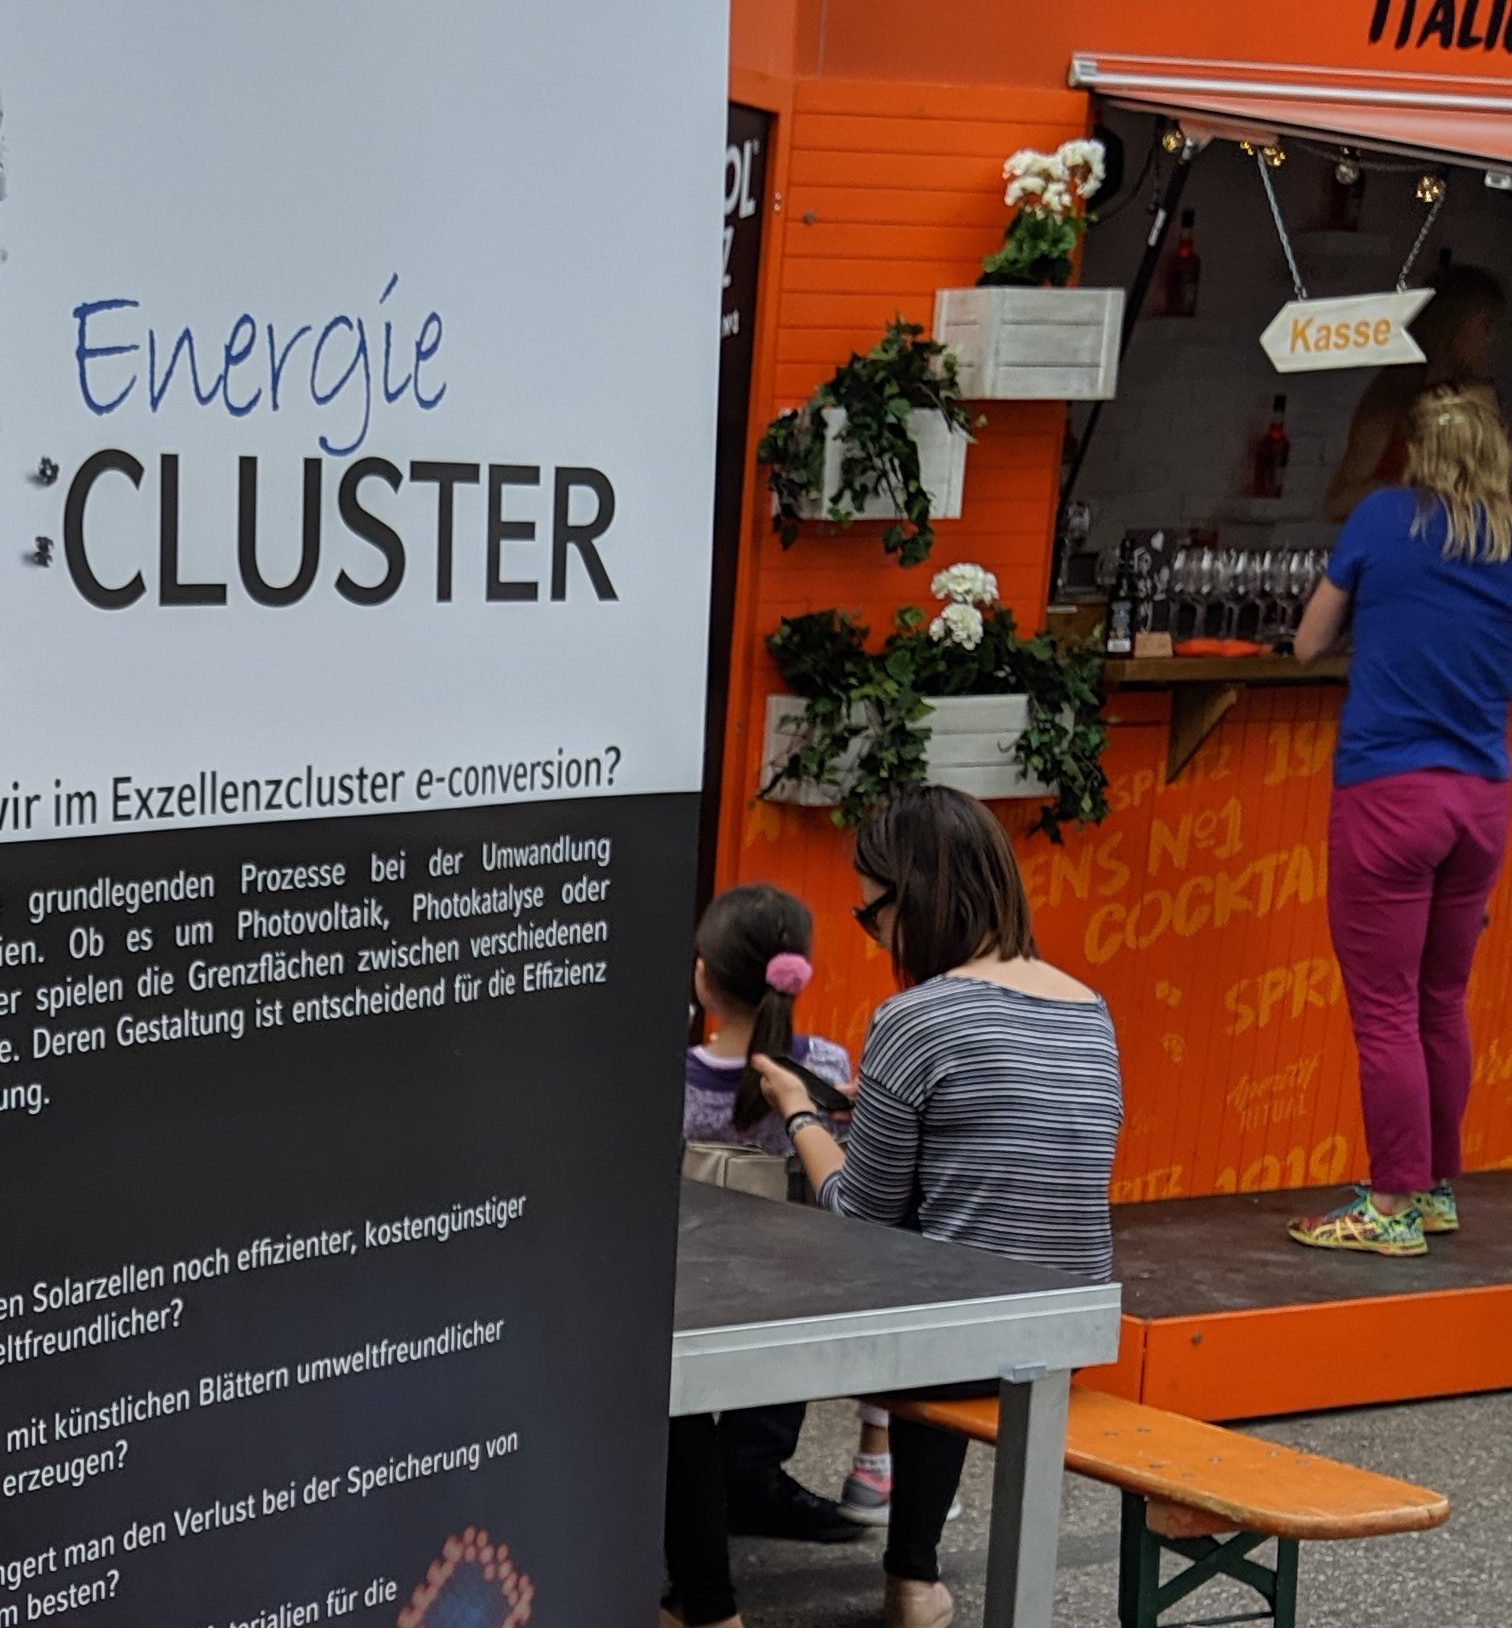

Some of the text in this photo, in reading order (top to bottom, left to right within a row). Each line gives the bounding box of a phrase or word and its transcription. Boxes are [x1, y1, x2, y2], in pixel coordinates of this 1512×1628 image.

[1368, 0, 1512, 53] ITALI
[73, 272, 447, 456] Energie
[1289, 313, 1391, 353] Kasse
[63, 448, 619, 610] CLUSTER
[54, 778, 96, 826] im
[113, 765, 404, 821] Exzellenzcluster
[416, 745, 620, 799] e-conversion?
[28, 870, 214, 923] grundlegenden
[241, 863, 345, 893] Prozesse
[371, 850, 405, 881] bei
[428, 847, 463, 876] der
[482, 835, 610, 870] Umwandlung
[69, 927, 103, 958] Ob
[126, 928, 152, 951] es
[175, 921, 212, 946] um
[238, 898, 389, 939] Photovoltaik,
[413, 883, 543, 921] Photokatalyse
[561, 875, 610, 903] oder
[1085, 842, 1329, 963] COCKTAI
[33, 1027, 104, 1058] Deren
[116, 1008, 243, 1046] Gestaltung
[256, 999, 282, 1027] ist
[292, 977, 444, 1022] entscheidend
[454, 973, 481, 1002] für
[488, 968, 515, 997] die
[523, 958, 606, 991] Effizienz
[36, 974, 122, 1017] spielen
[137, 966, 173, 997] die
[188, 949, 343, 990] Grenzflächen
[357, 936, 459, 971] zwischen
[470, 919, 606, 957] verschiedenen
[1224, 958, 1346, 1036] SPRI
[33, 1264, 163, 1312] Solarzellen
[173, 1248, 228, 1283] noch
[237, 1230, 356, 1270] effizienter,
[365, 1195, 526, 1247] kostengünstiger
[7, 1417, 47, 1452] mit
[55, 1389, 189, 1440] künstlichen
[199, 1367, 288, 1405] Blättern
[297, 1320, 503, 1383] umweltfreundlicher
[3, 1439, 127, 1496] erzeugen?
[64, 1535, 114, 1567] man
[123, 1521, 165, 1550] den
[173, 1495, 255, 1536] Verlust
[262, 1481, 294, 1514] bei
[303, 1476, 340, 1503] der
[347, 1443, 479, 1496] Speicherung
[485, 1432, 517, 1457] von
[27, 1569, 119, 1619] besten?
[326, 1590, 357, 1617] für
[364, 1580, 396, 1606] die
